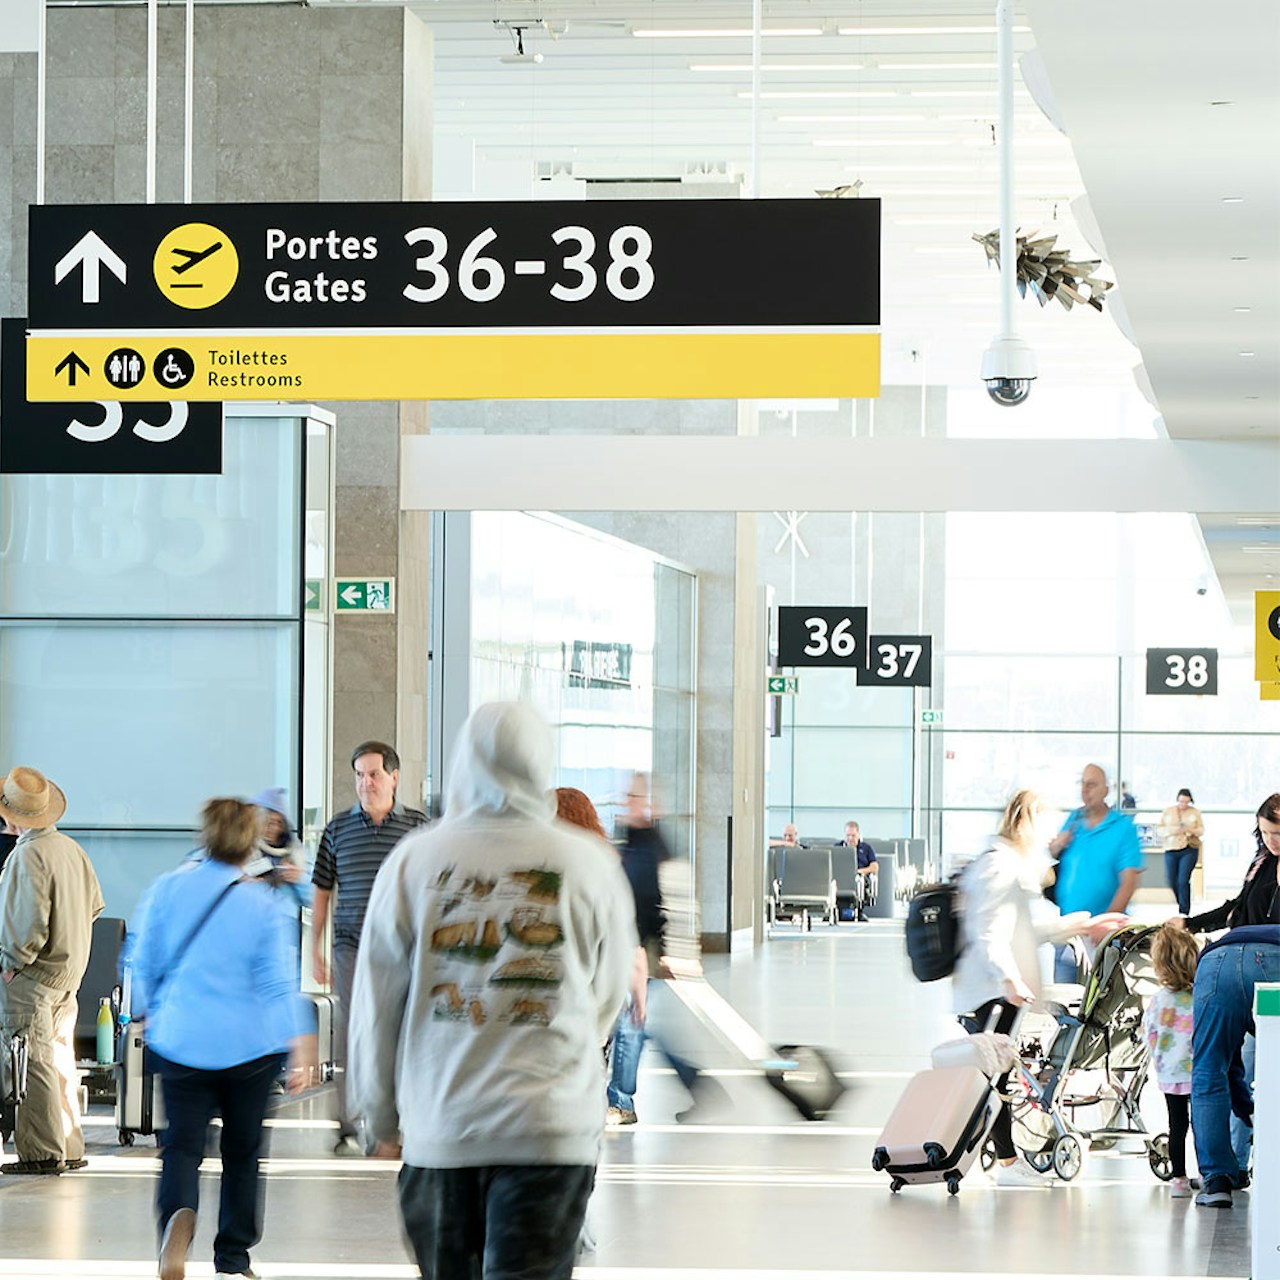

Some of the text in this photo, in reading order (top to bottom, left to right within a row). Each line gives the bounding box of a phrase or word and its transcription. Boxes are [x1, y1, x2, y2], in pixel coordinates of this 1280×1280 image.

[265, 226, 655, 303] Portes 36-38
[265, 271, 367, 303] Gates
[208, 349, 288, 366] Toilettes
[208, 371, 303, 388] Restrooms
[803, 617, 856, 657] 36
[876, 644, 923, 678] 37
[1165, 654, 1209, 688] 38
